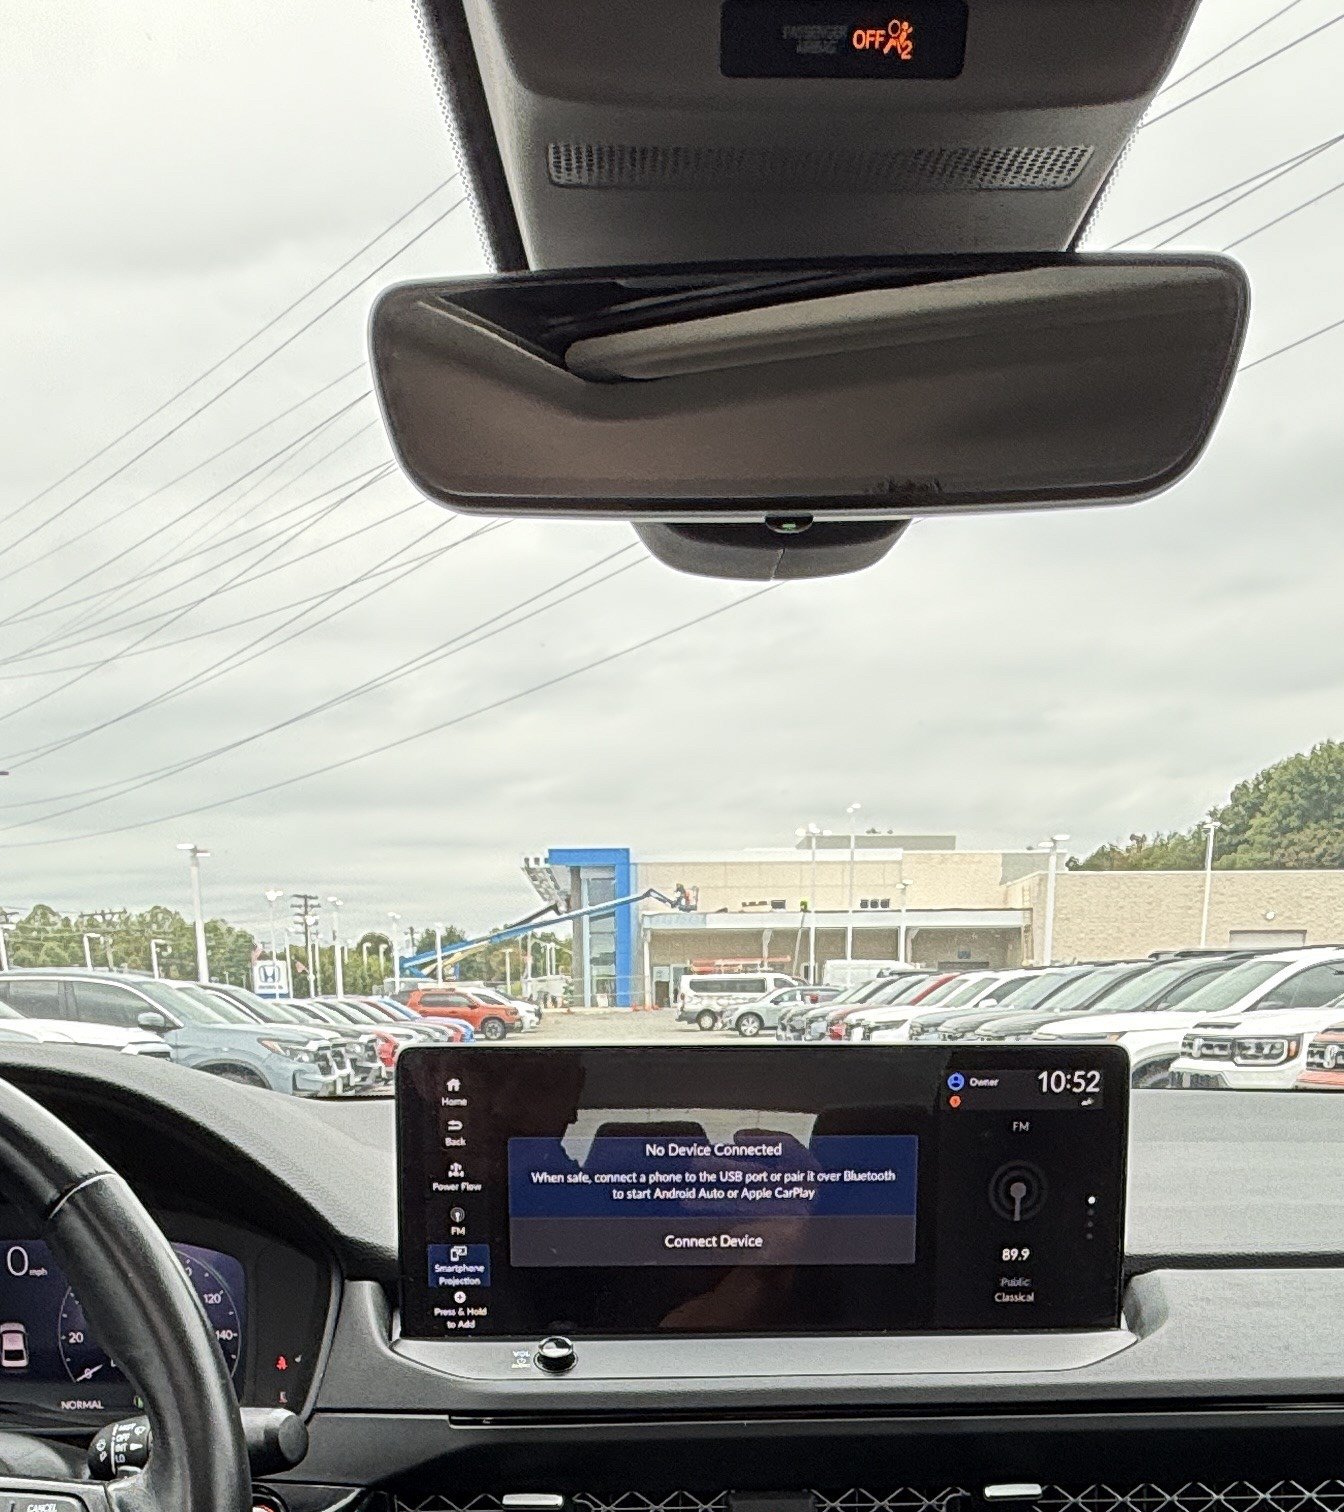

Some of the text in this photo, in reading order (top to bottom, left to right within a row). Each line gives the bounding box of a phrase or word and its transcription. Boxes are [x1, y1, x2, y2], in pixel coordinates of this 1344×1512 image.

[852, 29, 887, 49] OFF
[969, 1077, 1000, 1087] Owner
[1037, 1070, 1100, 1093] 10:52
[441, 1097, 468, 1107] Home
[1012, 1121, 1030, 1132] FM
[444, 1136, 467, 1147] Back
[645, 1142, 782, 1156] No Device Connected
[531, 1169, 896, 1185] When safe, connect a phone to the USB port or pair it over Bluetooth
[432, 1181, 482, 1192] Power Flow
[612, 1187, 816, 1201] to start Android Auto or Apple CarPlay
[450, 1226, 466, 1236] FM
[664, 1234, 763, 1248] Connect Device
[1001, 1248, 1030, 1261] 89.9
[6, 1246, 48, 1278] 0 mph
[434, 1264, 485, 1275] Smartphone
[438, 1276, 481, 1287] Projection
[999, 1276, 1031, 1287] Public
[203, 1293, 222, 1305] 120
[994, 1292, 1035, 1303] Classical
[434, 1306, 487, 1317] Press & Hold
[447, 1319, 476, 1330] to Add
[68, 1332, 84, 1344] 20
[215, 1329, 233, 1341] 140
[60, 1400, 104, 1410] NORMAL
